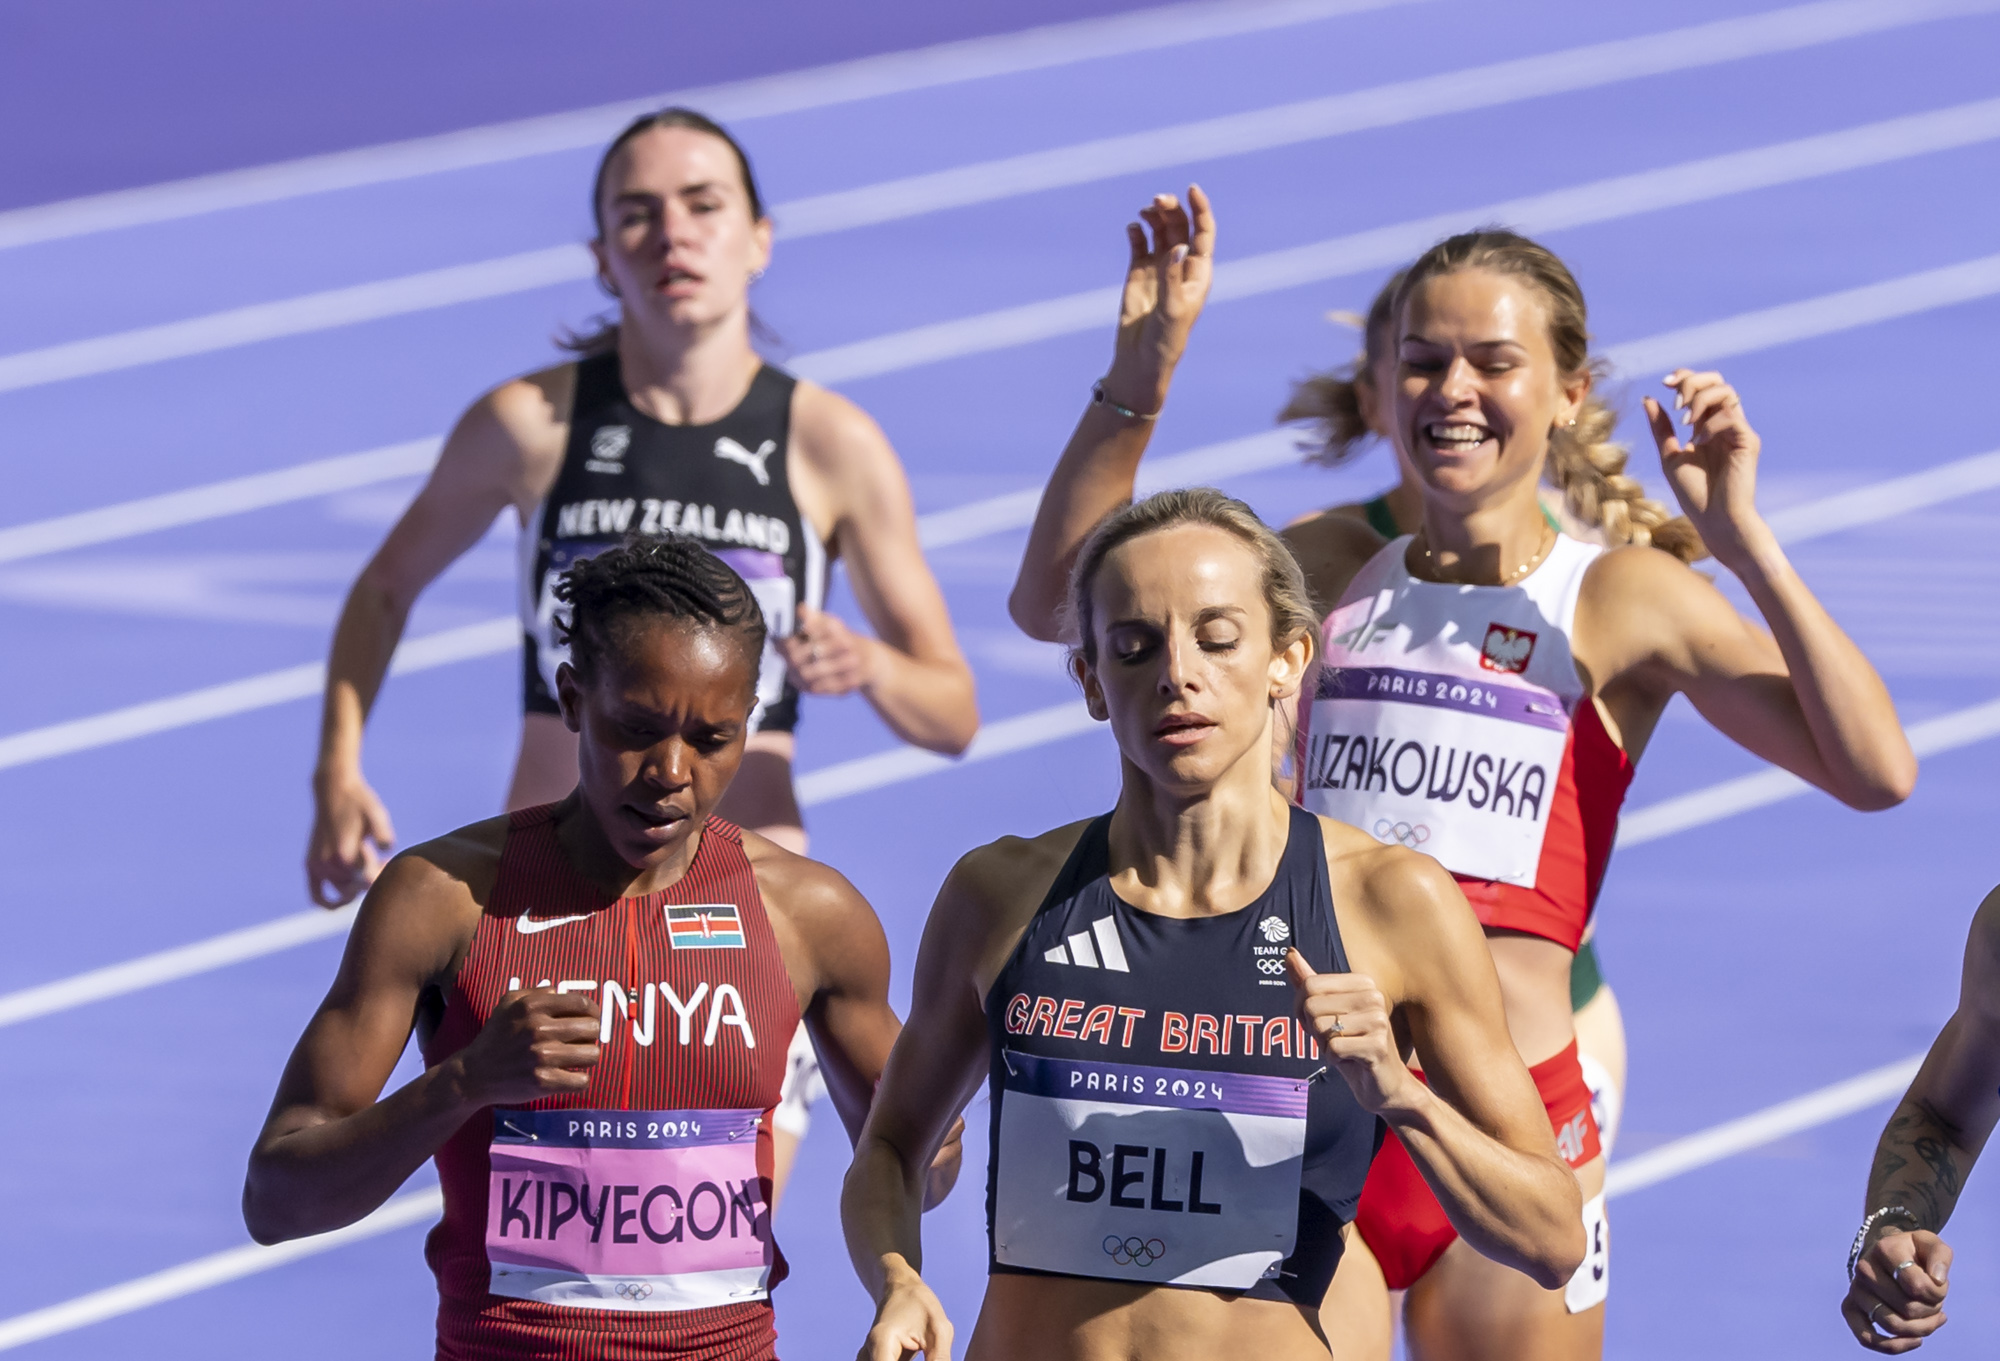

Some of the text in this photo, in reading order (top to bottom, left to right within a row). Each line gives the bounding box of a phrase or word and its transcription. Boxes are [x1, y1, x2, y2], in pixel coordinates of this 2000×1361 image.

[557, 498, 790, 555] NEW ZEALAND
[1367, 673, 1498, 709] PARIS 2024
[1306, 733, 1546, 821] LIZAKOWSKA
[1253, 946, 1289, 956] TEAM G
[509, 977, 755, 1049] NYA
[1004, 993, 1146, 1048] GREAT
[1070, 1071, 1223, 1101] PARIS 2024
[569, 1120, 701, 1139] PARIS 2024
[1066, 1139, 1222, 1216] BELL
[499, 1178, 758, 1244] KIPYEGON
